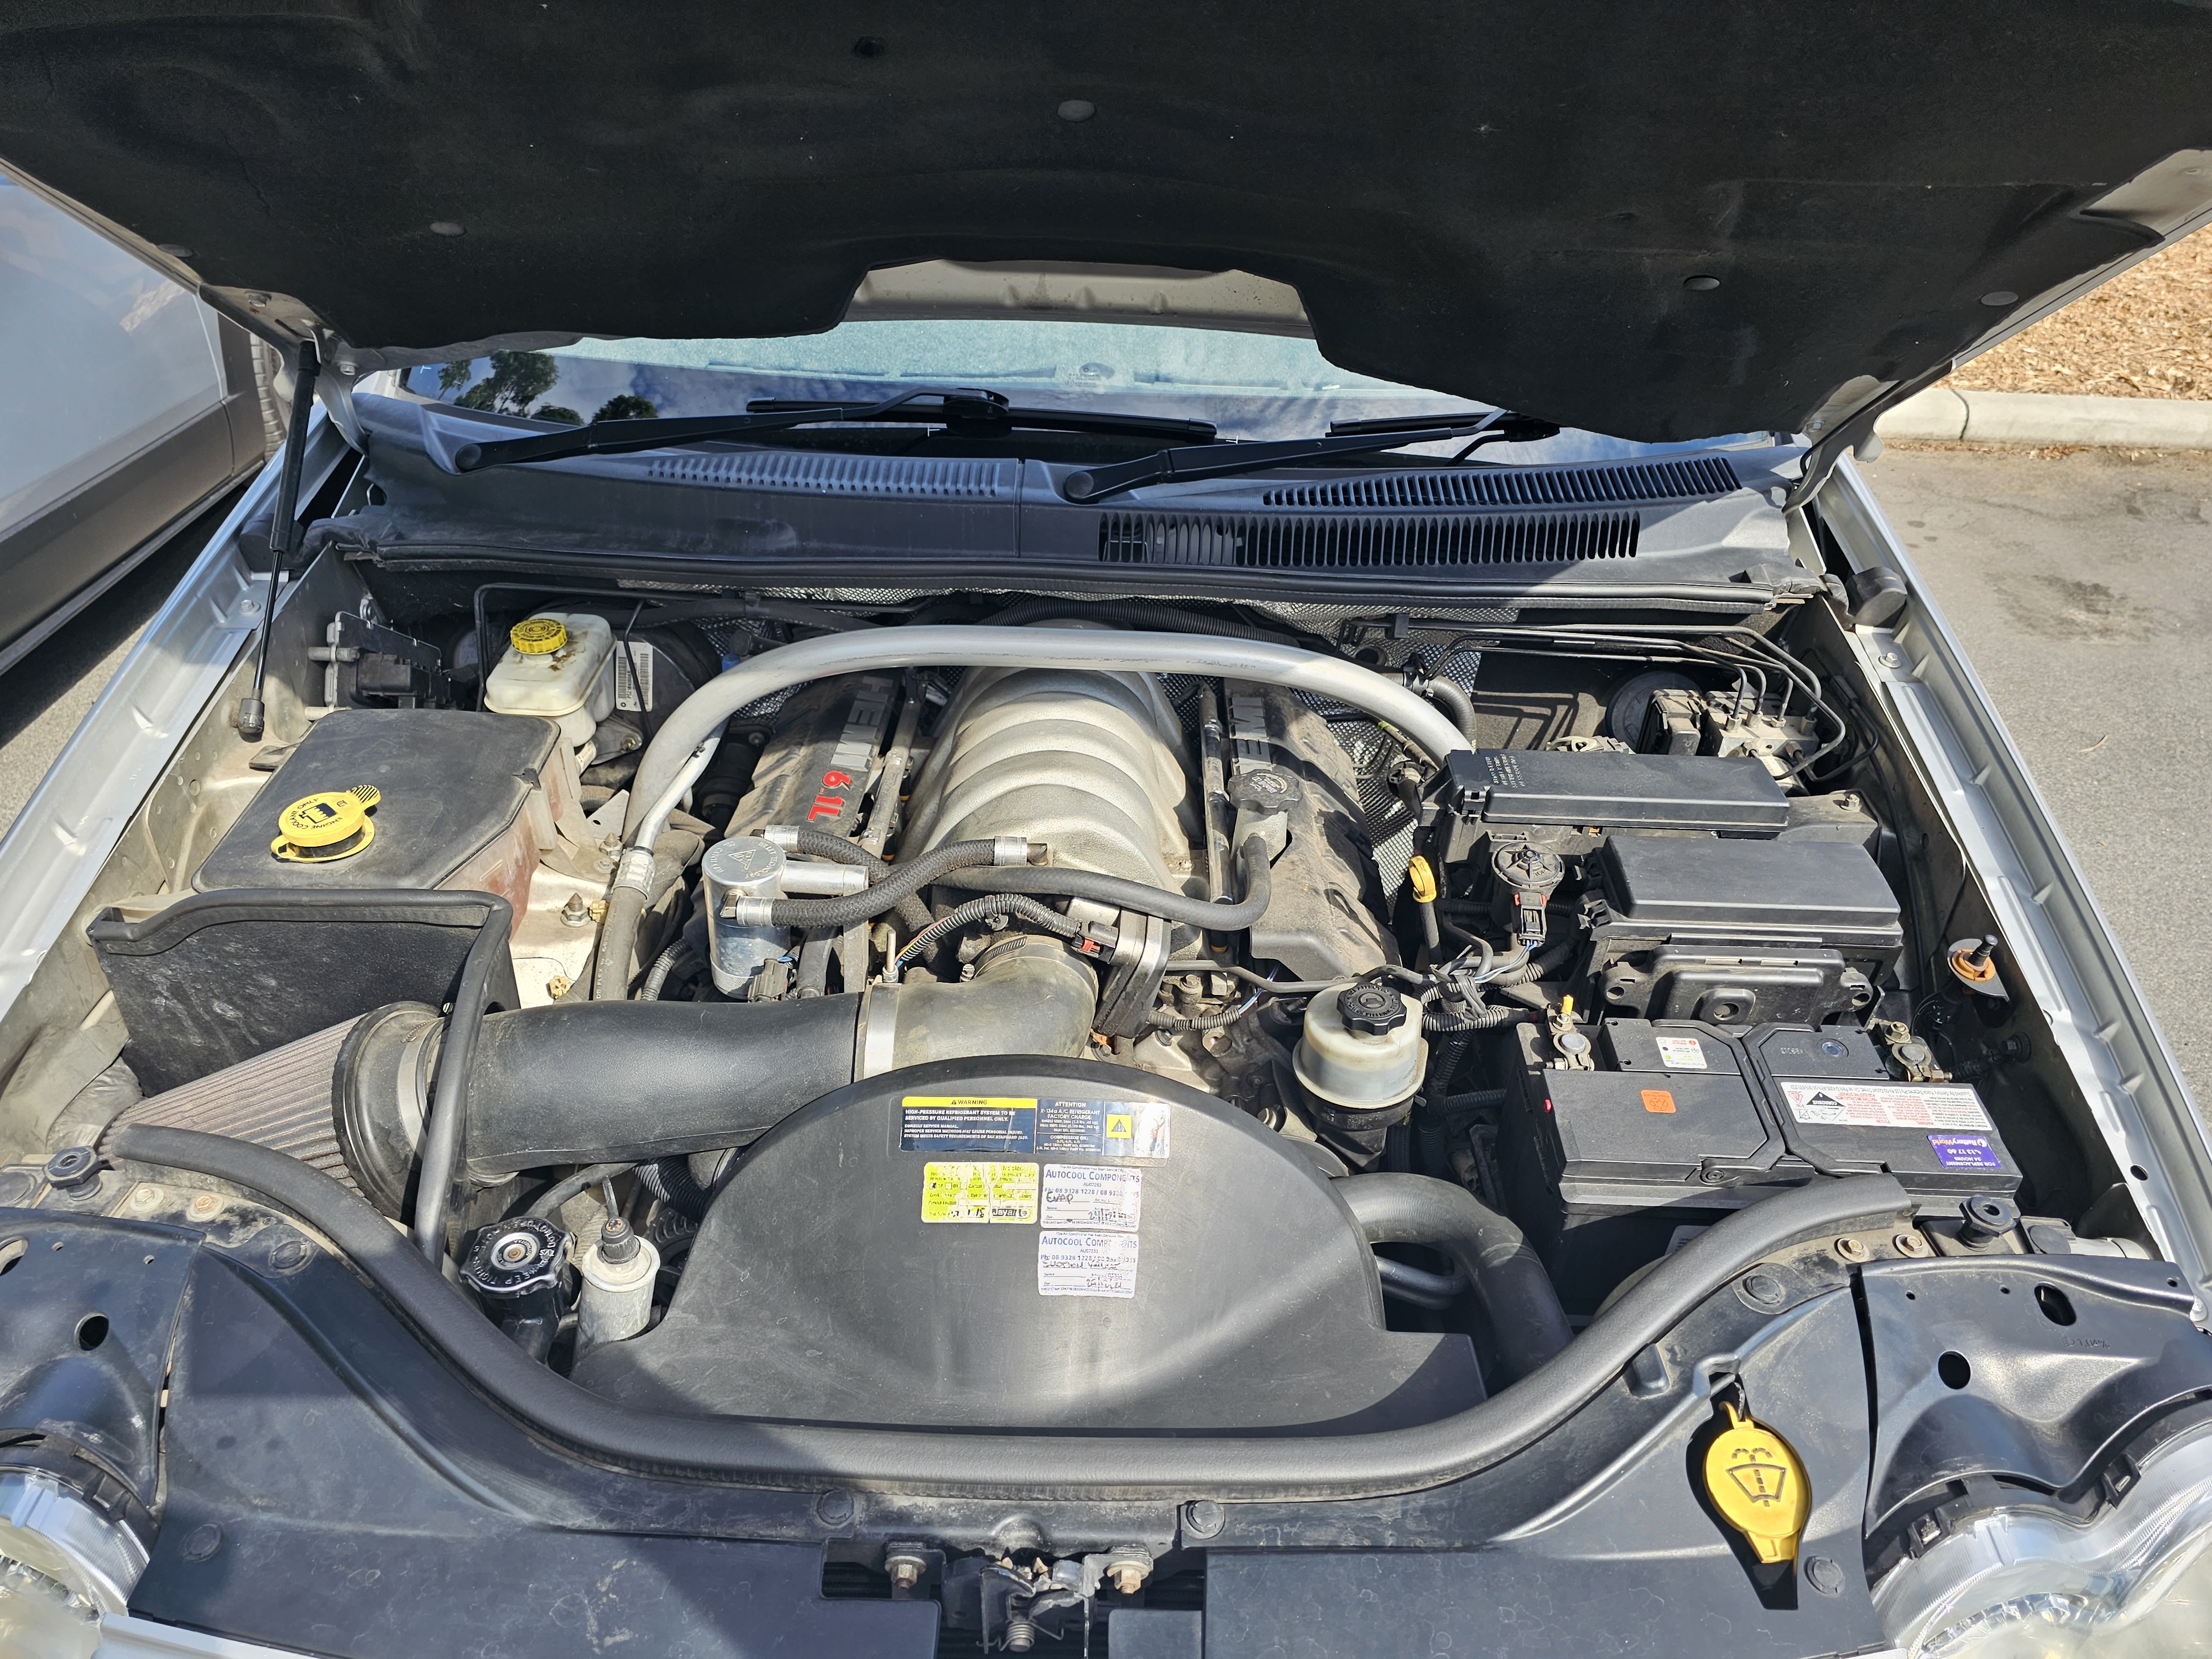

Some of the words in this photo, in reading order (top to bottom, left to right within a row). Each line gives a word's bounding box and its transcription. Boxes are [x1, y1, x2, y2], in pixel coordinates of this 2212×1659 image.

[830, 676, 894, 773] HEMI
[806, 770, 851, 821] 6.1L
[298, 798, 319, 809] ONLY
[1045, 1170, 1087, 1180] AUTOCOOL
[1041, 1236, 1083, 1246] AUTOCOOL
